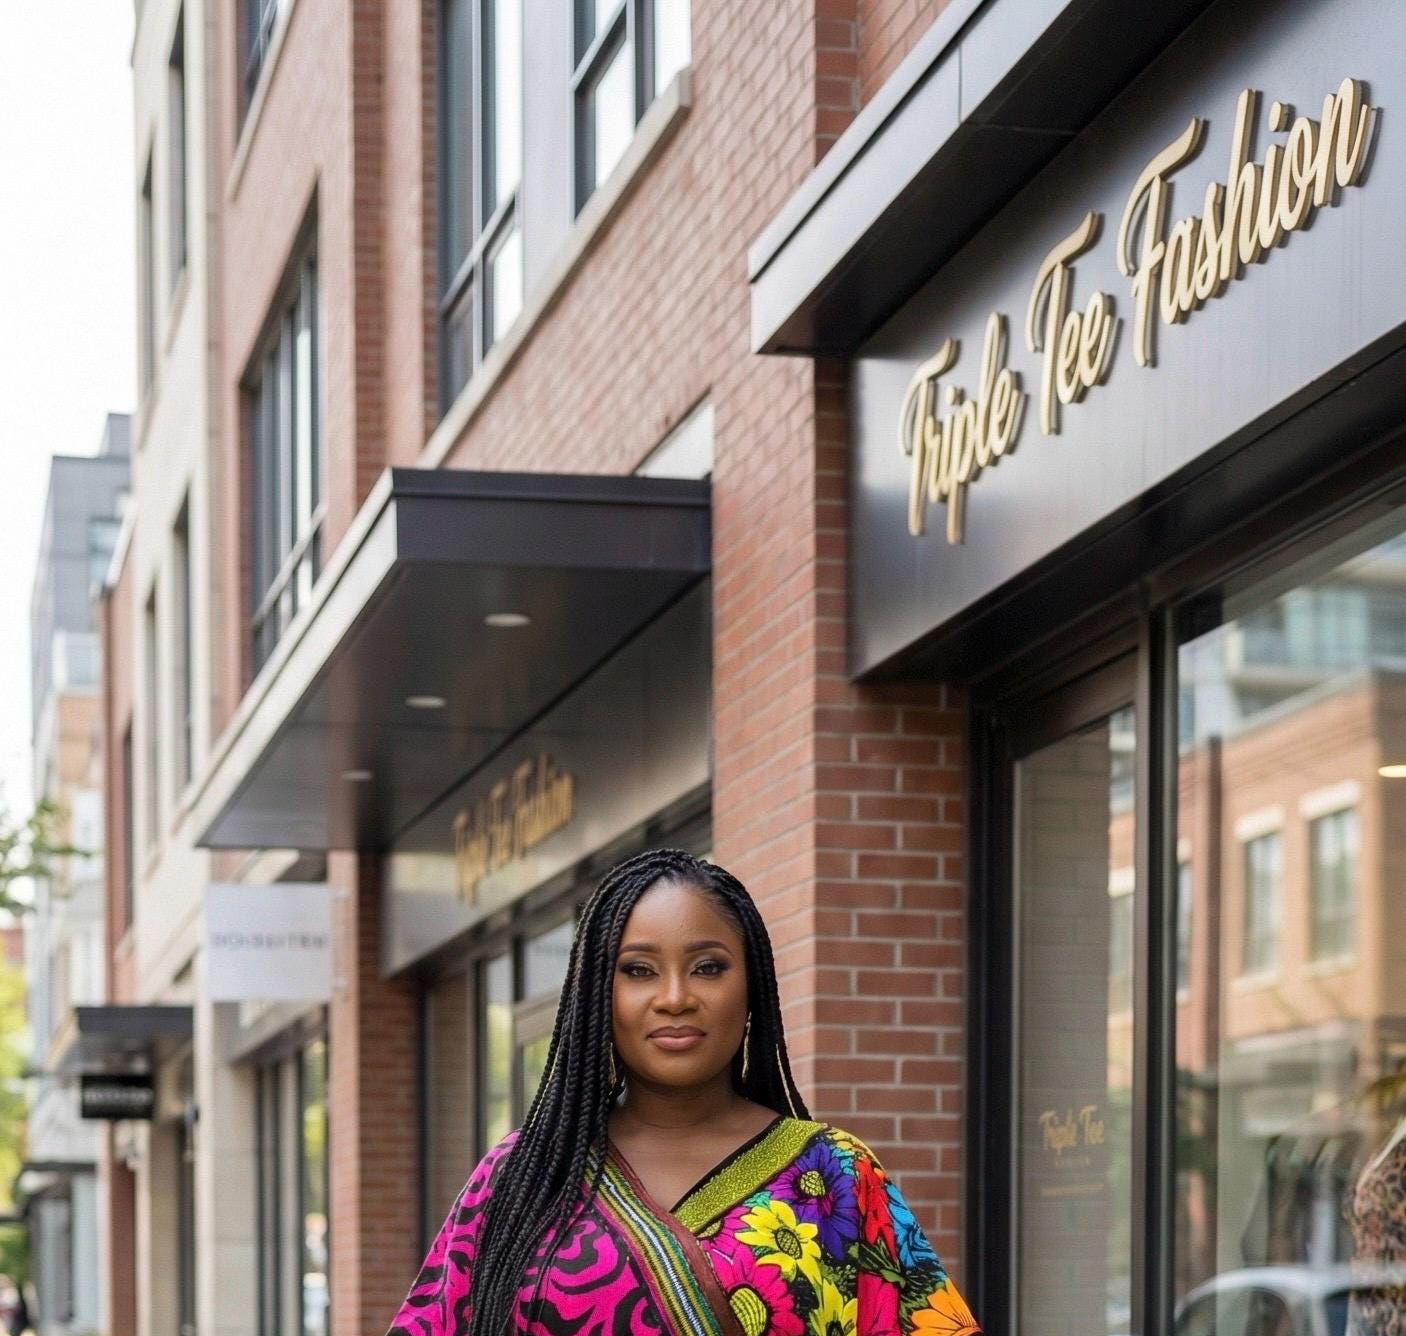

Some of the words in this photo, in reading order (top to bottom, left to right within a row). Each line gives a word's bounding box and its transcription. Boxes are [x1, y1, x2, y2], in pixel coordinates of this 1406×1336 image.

[898, 312, 1024, 546] Triple
[1027, 211, 1116, 437] Tee
[1118, 78, 1375, 368] Fashion
